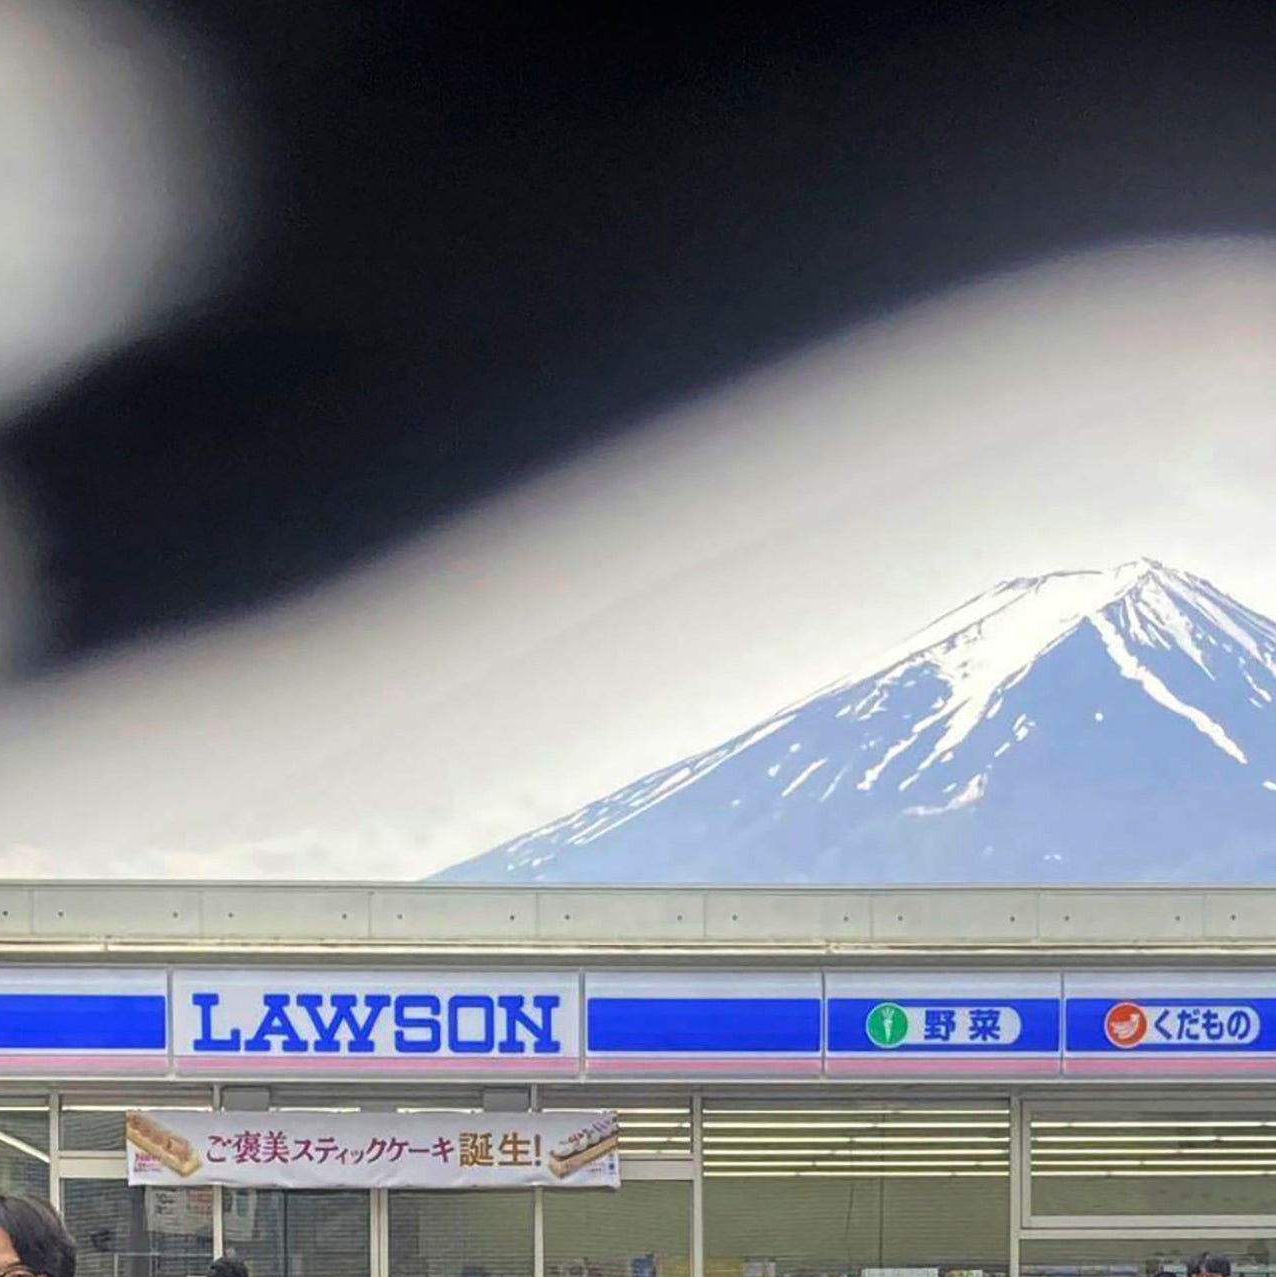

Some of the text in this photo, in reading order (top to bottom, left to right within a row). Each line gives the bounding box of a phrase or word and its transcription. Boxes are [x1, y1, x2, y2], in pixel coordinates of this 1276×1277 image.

[191, 993, 562, 1054] LAWSON
[924, 1009, 1002, 1042] 野菜
[1153, 1009, 1251, 1041] くだもの
